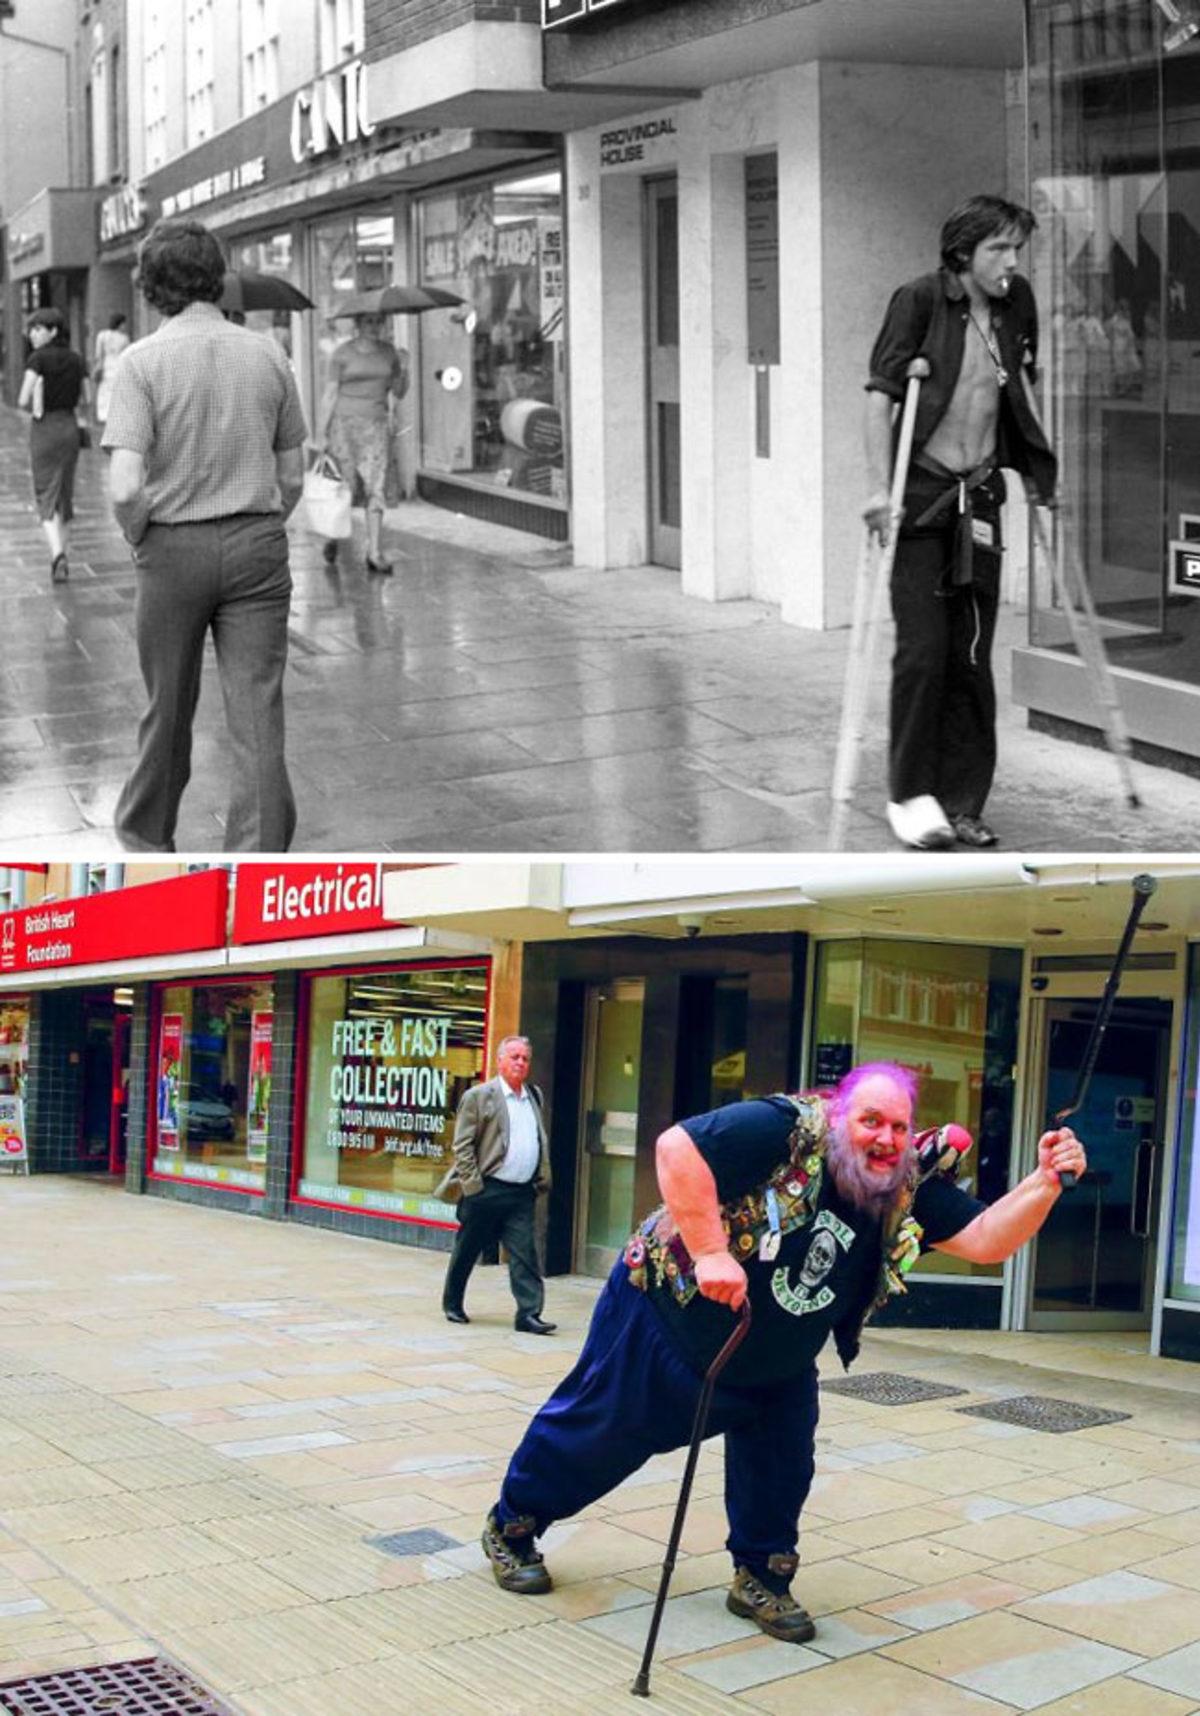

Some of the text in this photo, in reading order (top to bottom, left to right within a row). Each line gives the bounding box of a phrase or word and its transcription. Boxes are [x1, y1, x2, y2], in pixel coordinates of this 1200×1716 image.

[600, 117, 677, 148] PROVINCIAL
[600, 144, 645, 167] HOUSE
[262, 862, 383, 922] Electrical
[25, 909, 75, 935] British Heart
[26, 940, 72, 963] Foundation
[332, 1018, 452, 1057] FREE & FAST
[330, 1065, 447, 1108] COLLECTION
[341, 1108, 363, 1126] YOUR
[363, 1109, 414, 1130] UNWANTED
[415, 1114, 445, 1133] ITEMS
